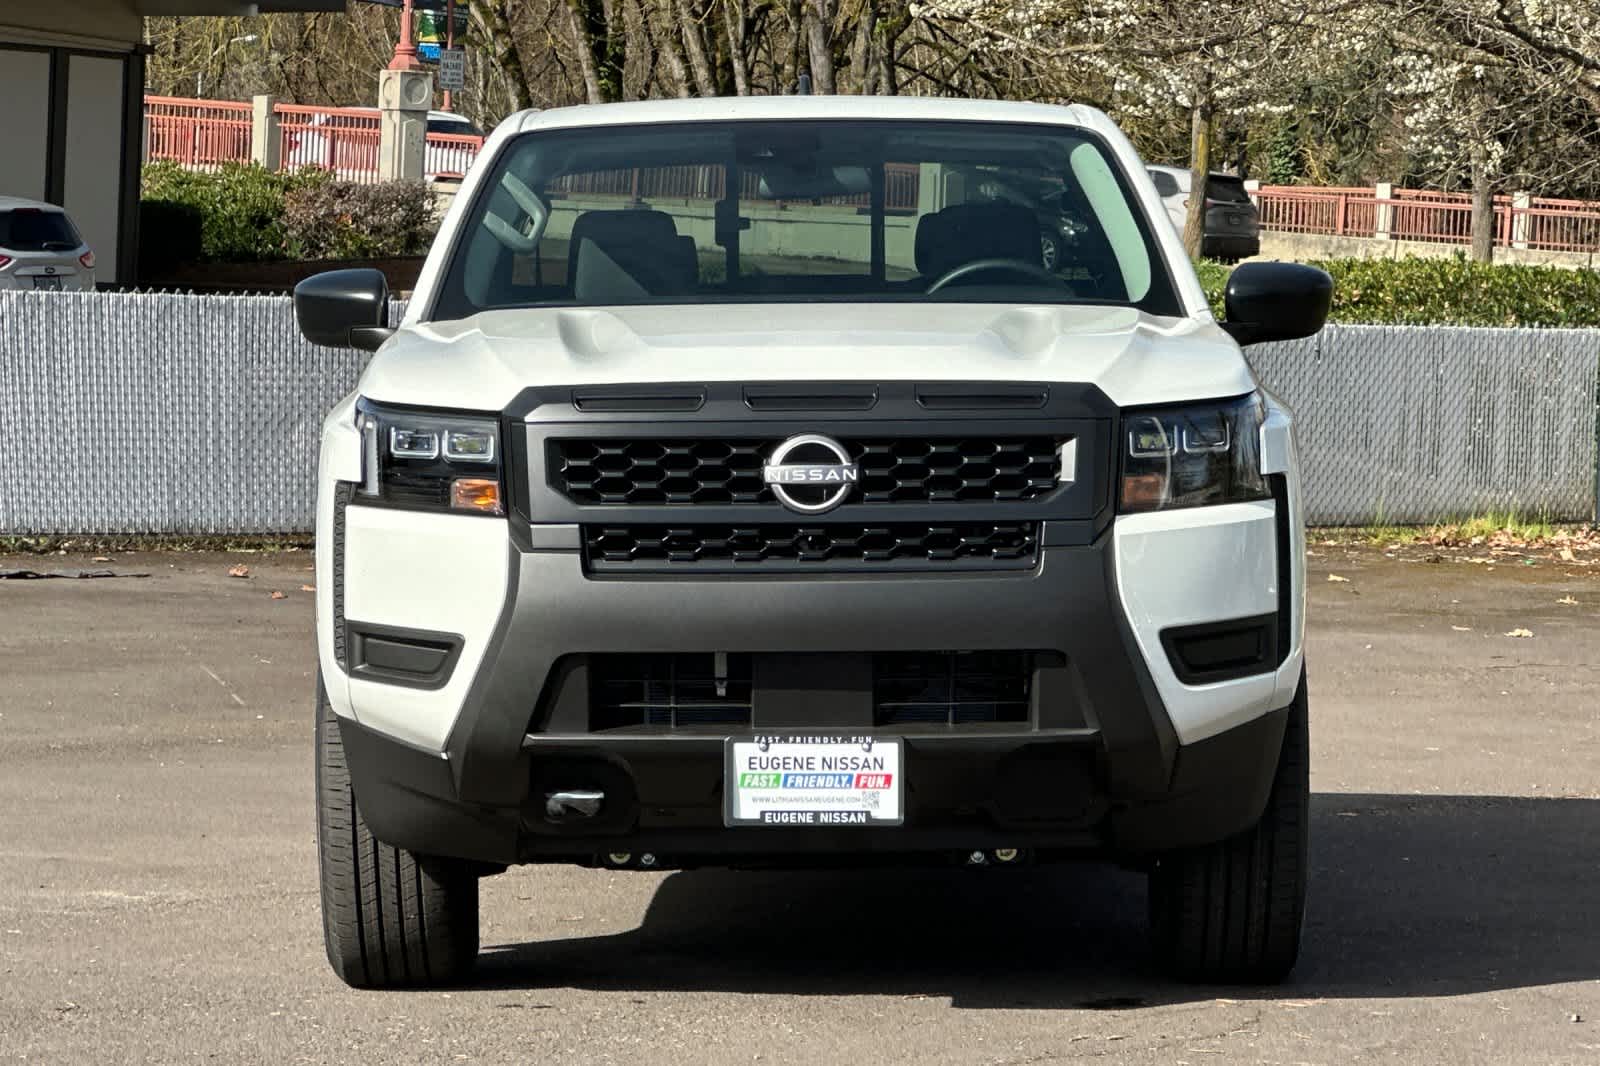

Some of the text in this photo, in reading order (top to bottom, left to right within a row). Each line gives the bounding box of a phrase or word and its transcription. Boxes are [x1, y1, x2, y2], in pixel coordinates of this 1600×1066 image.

[767, 469, 857, 481] NISSAN
[748, 757, 884, 771] EUGENE NISSAN
[743, 775, 889, 788] FAST. FRIENDLY. FUN.
[765, 812, 866, 824] EUGENE NISSAN
